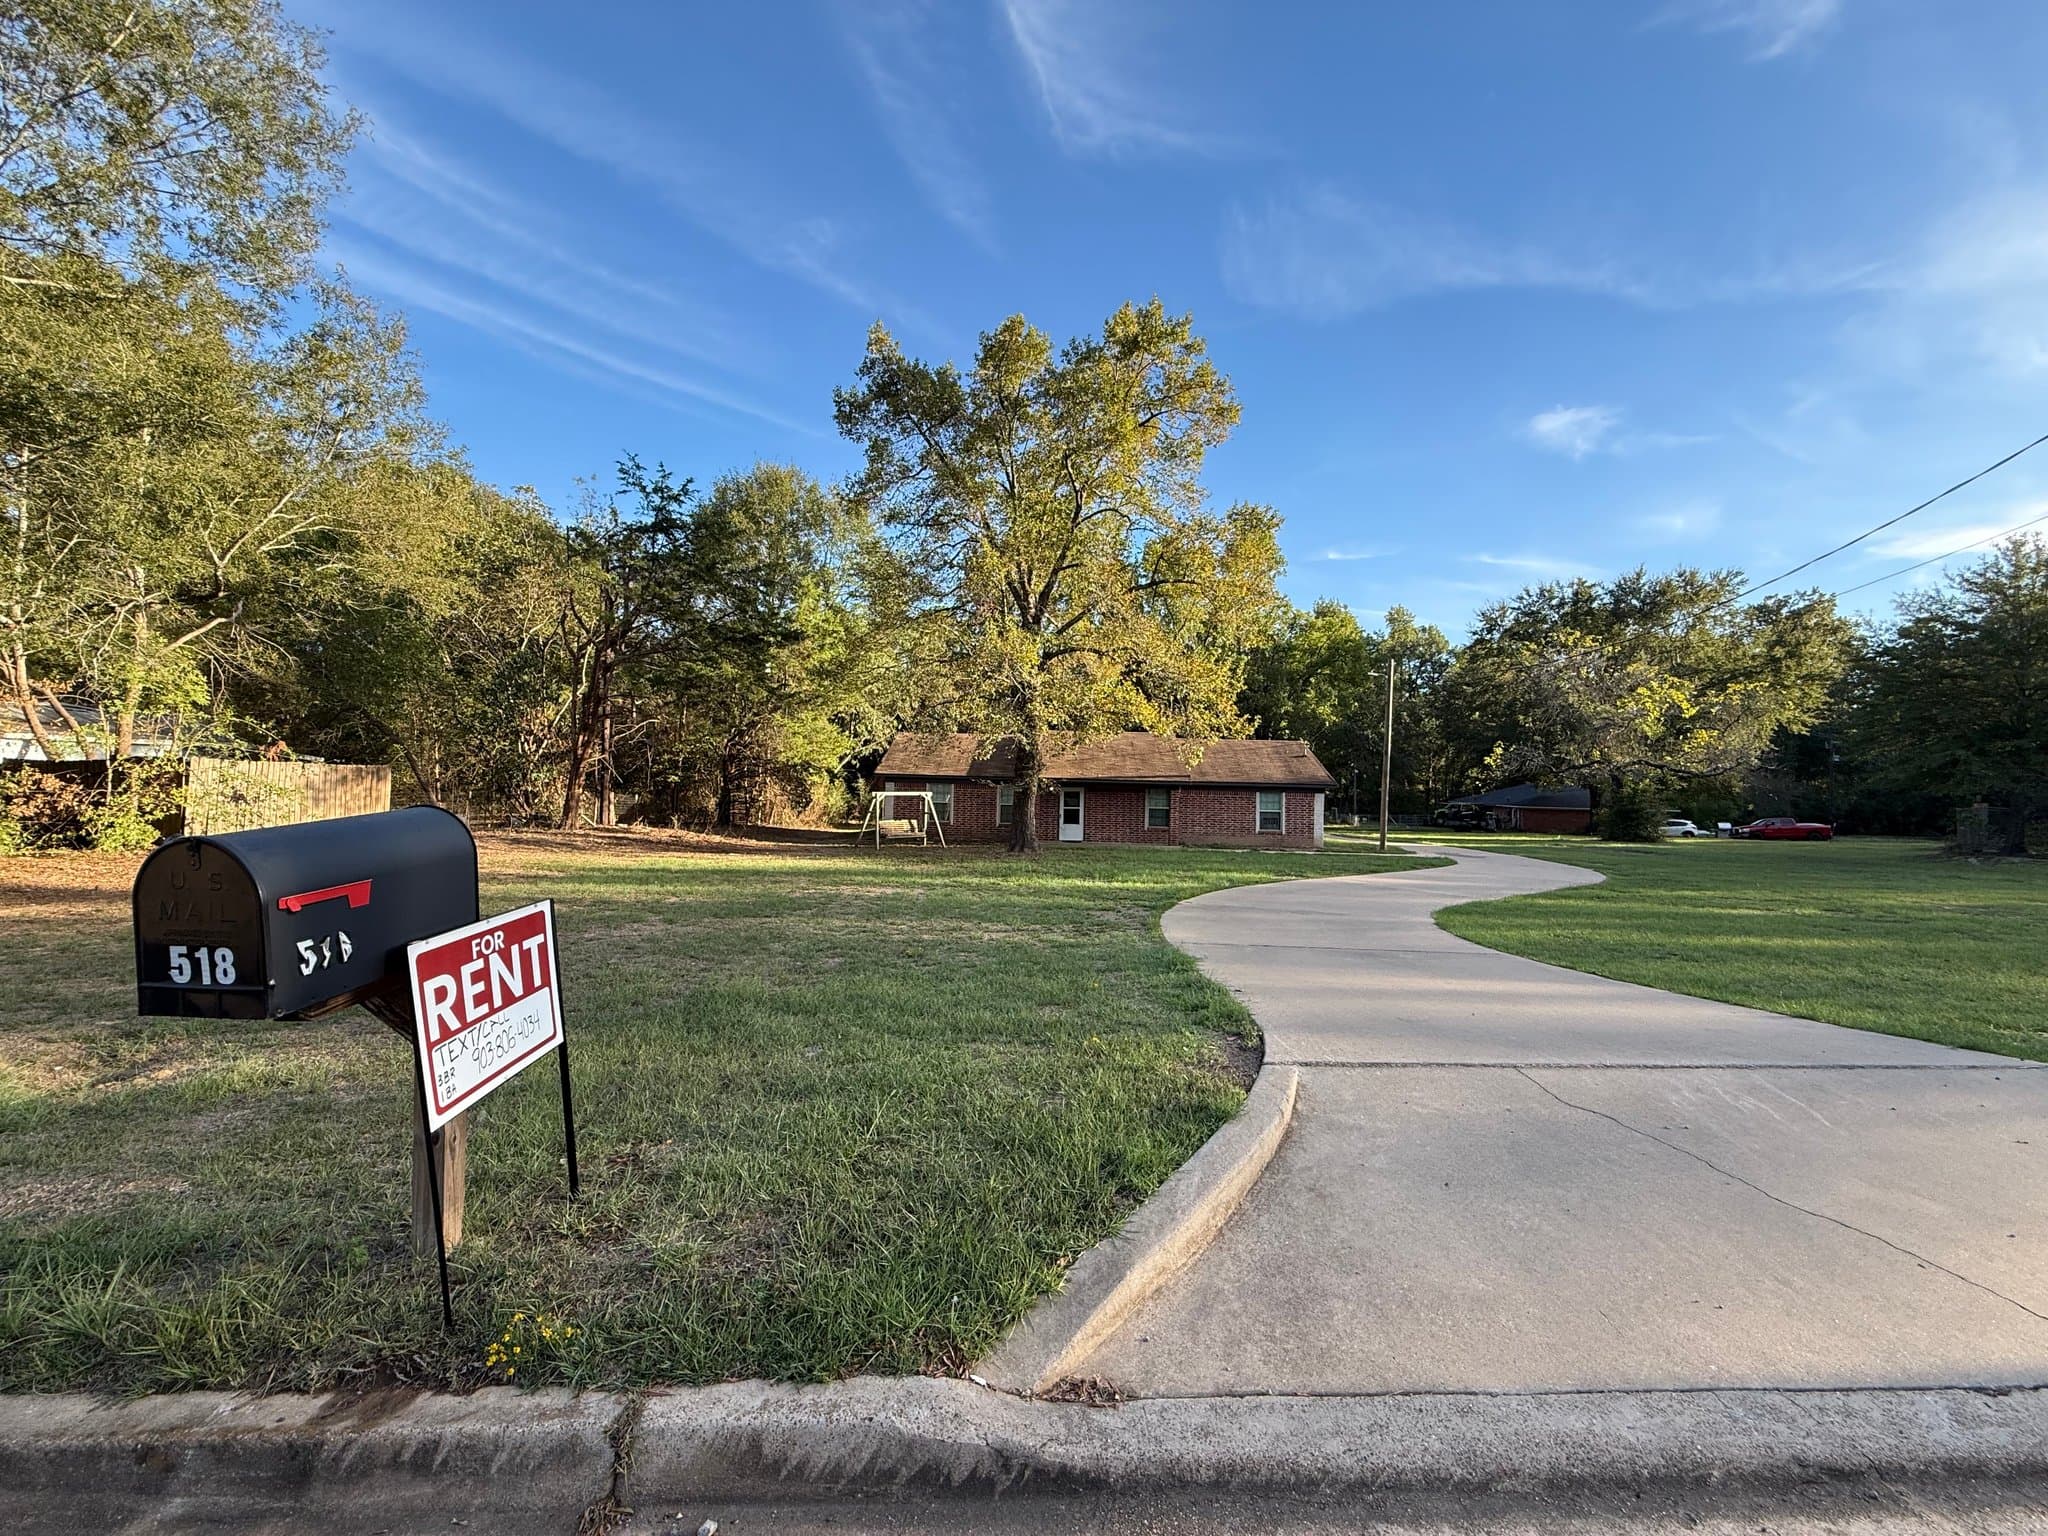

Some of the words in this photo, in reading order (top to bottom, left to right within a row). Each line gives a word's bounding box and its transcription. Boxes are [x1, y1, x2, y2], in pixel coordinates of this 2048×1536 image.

[471, 930, 504, 959] FOR
[168, 945, 236, 985] 518
[423, 933, 545, 1043] RENT
